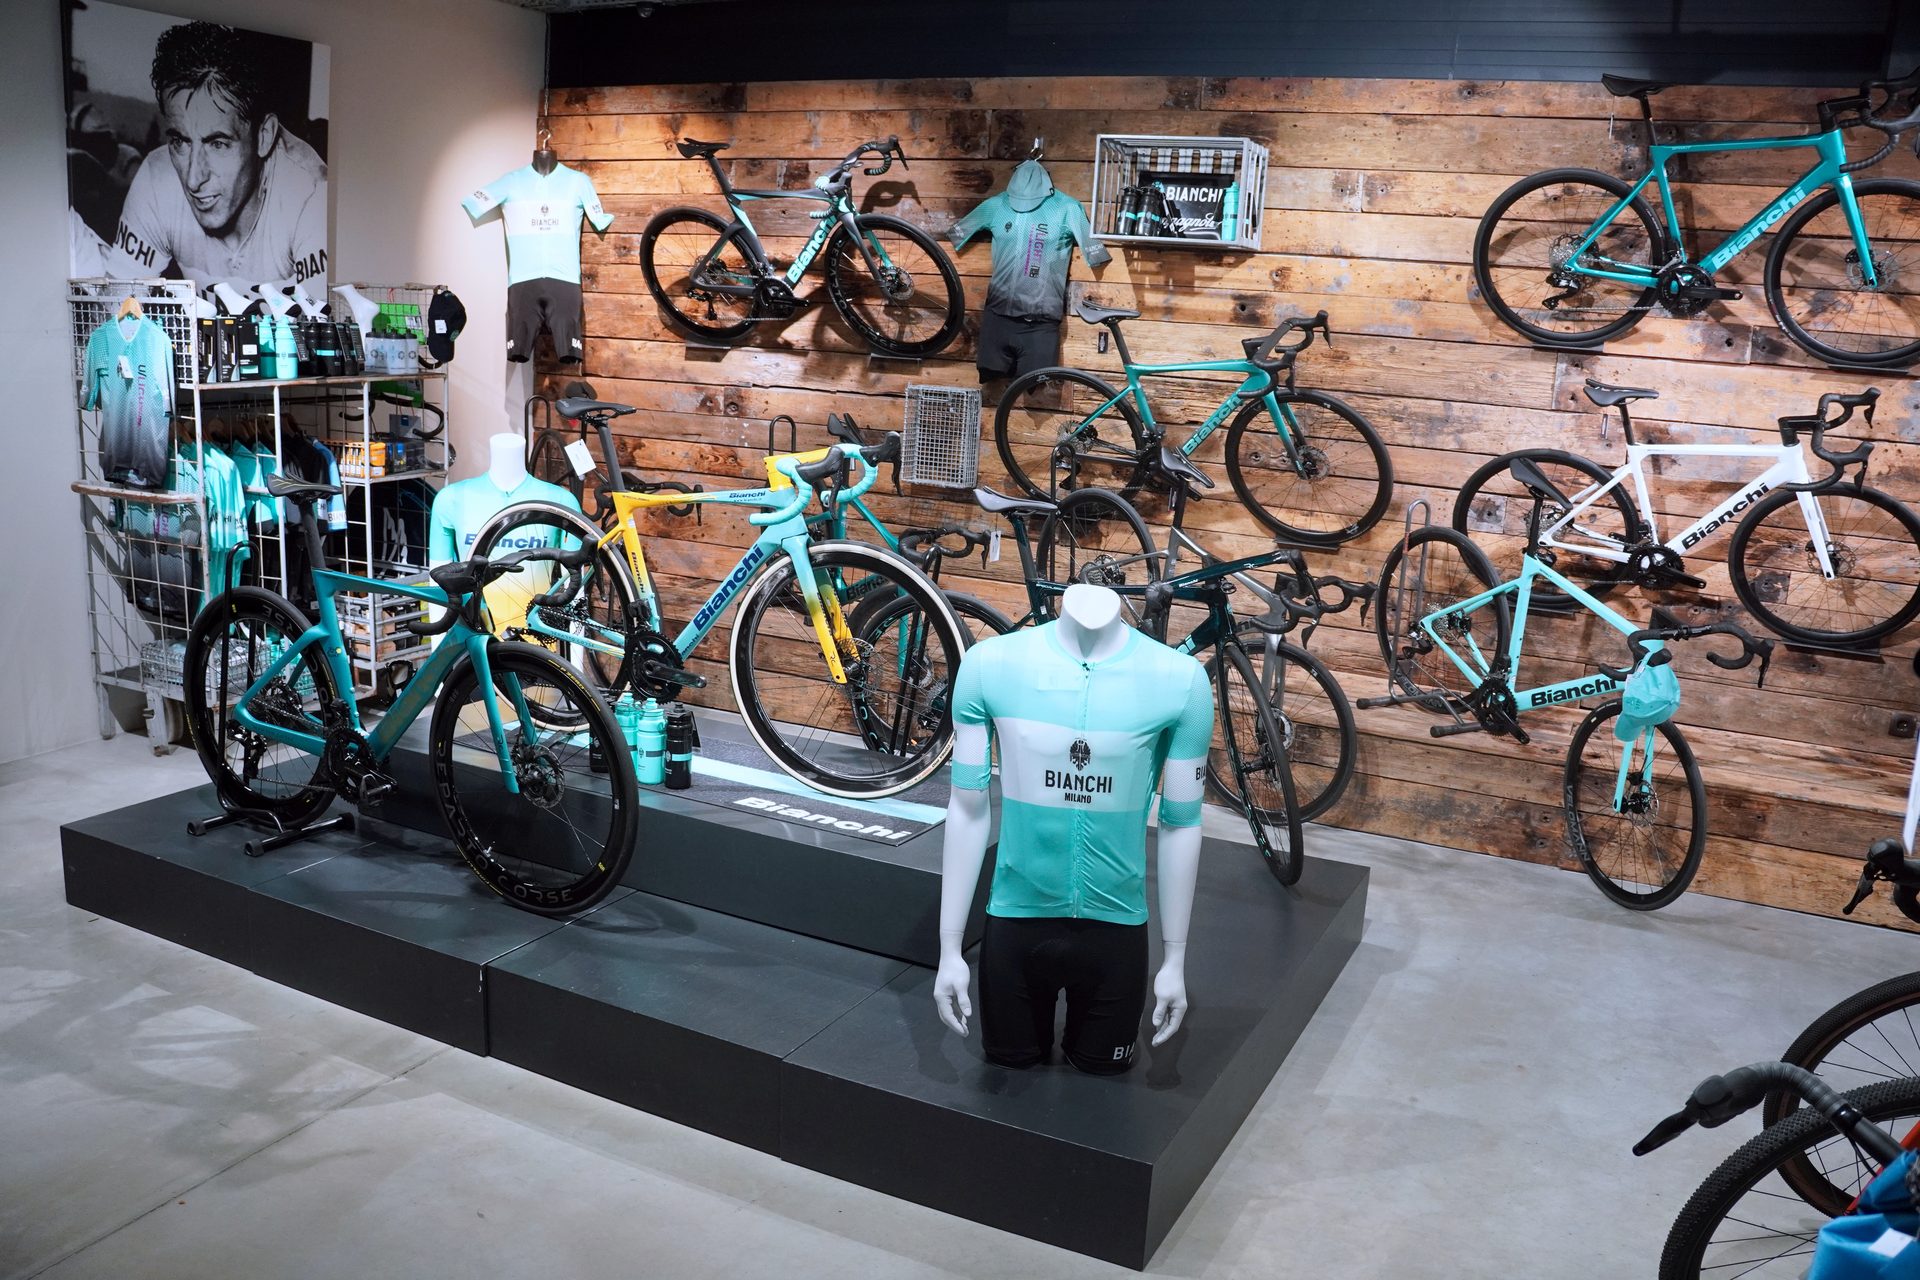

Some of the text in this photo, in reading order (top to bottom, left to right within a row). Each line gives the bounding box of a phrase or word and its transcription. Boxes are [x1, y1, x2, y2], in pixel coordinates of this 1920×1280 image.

[1711, 187, 1806, 270] Bianchi
[729, 490, 766, 499] Bianchi
[1681, 482, 1770, 550] Bianchi
[464, 533, 548, 549] Bnchi
[631, 551, 646, 594] Bianchi
[693, 545, 764, 632] Bianchi
[1531, 679, 1617, 707] Bianchi
[1044, 769, 1113, 794] BIANCHI
[1064, 792, 1092, 804] MILANO
[733, 797, 913, 840] Bianchi
[1566, 785, 1592, 862] VELOMANN
